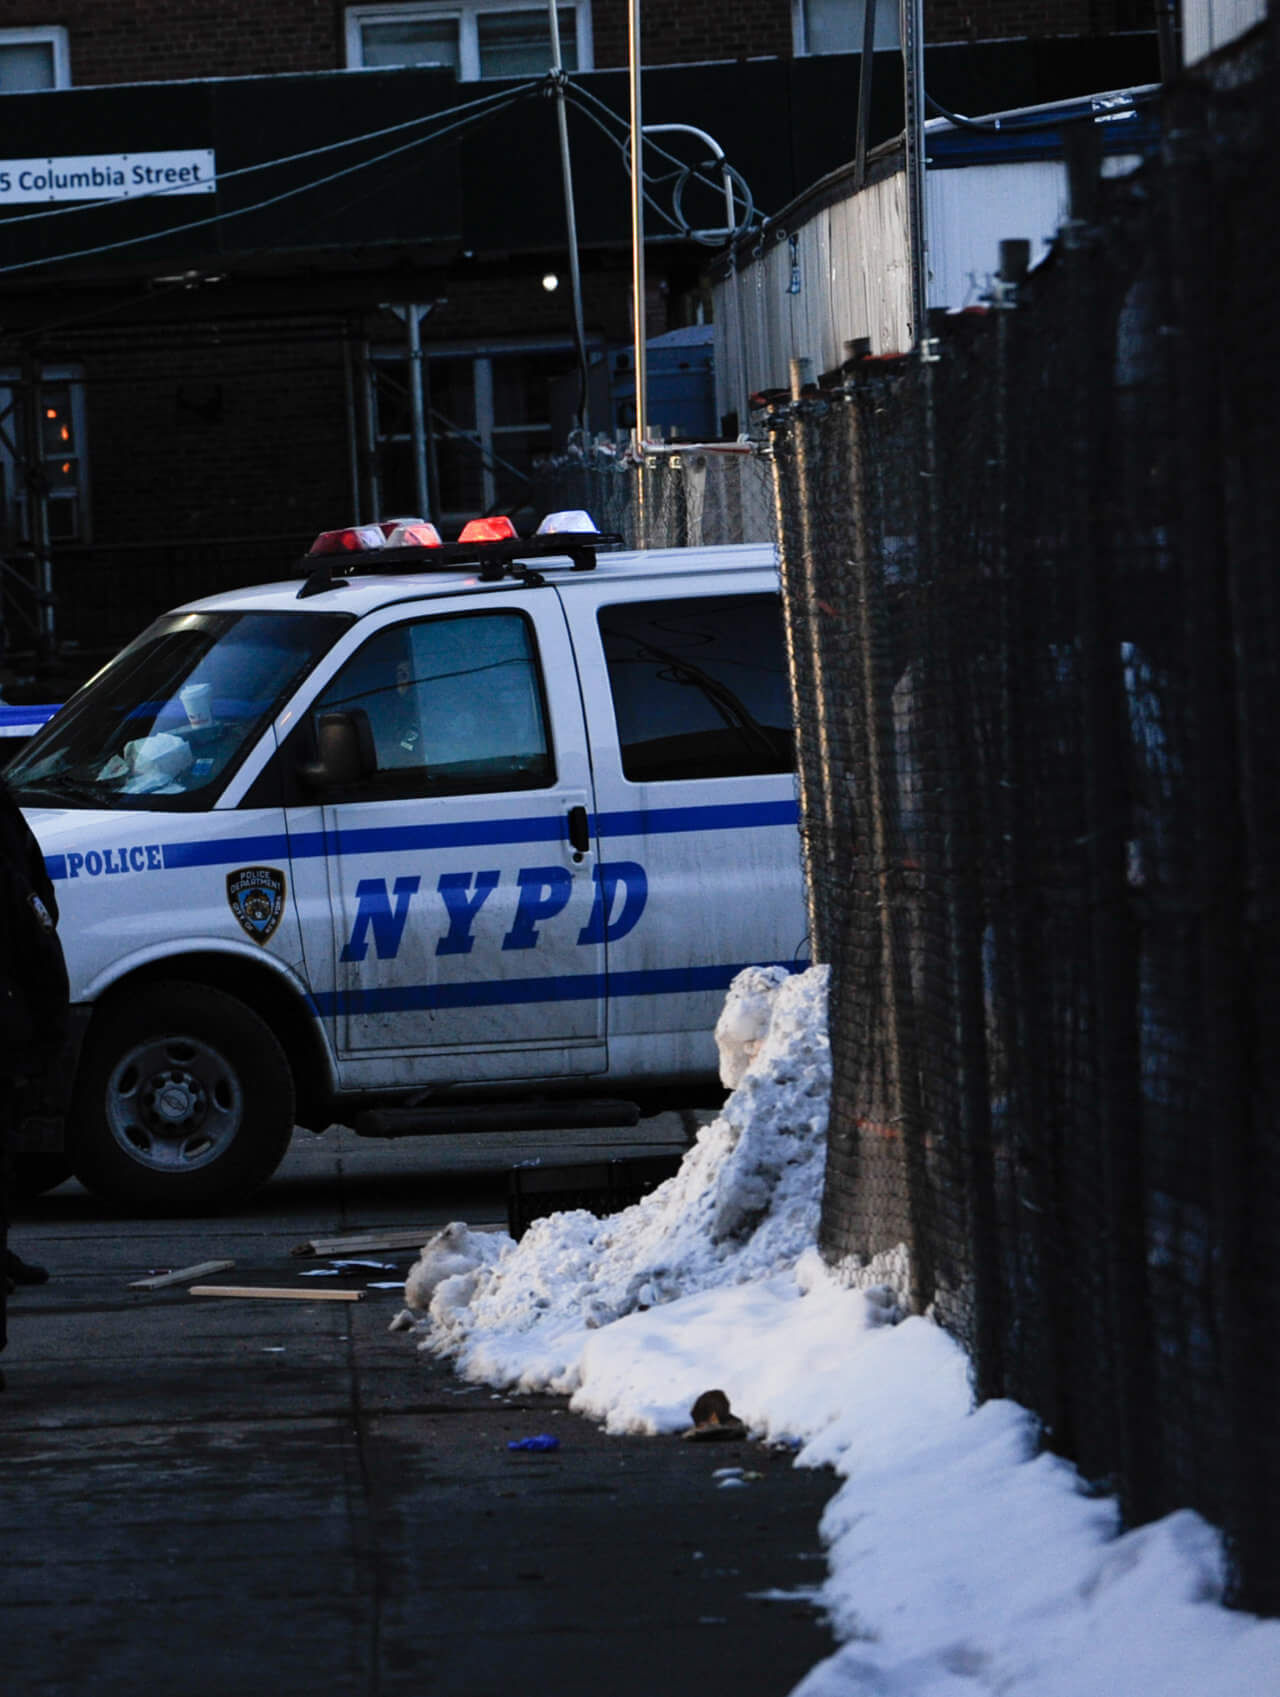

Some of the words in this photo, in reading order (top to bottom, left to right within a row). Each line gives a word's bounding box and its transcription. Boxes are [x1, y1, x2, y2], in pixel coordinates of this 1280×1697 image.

[19, 167, 125, 190] Columbia
[132, 164, 200, 184] Street
[67, 844, 161, 877] POLICE
[231, 879, 281, 894] DEPARTMENT
[239, 871, 271, 880] POLICE
[340, 861, 648, 962] NYPD
